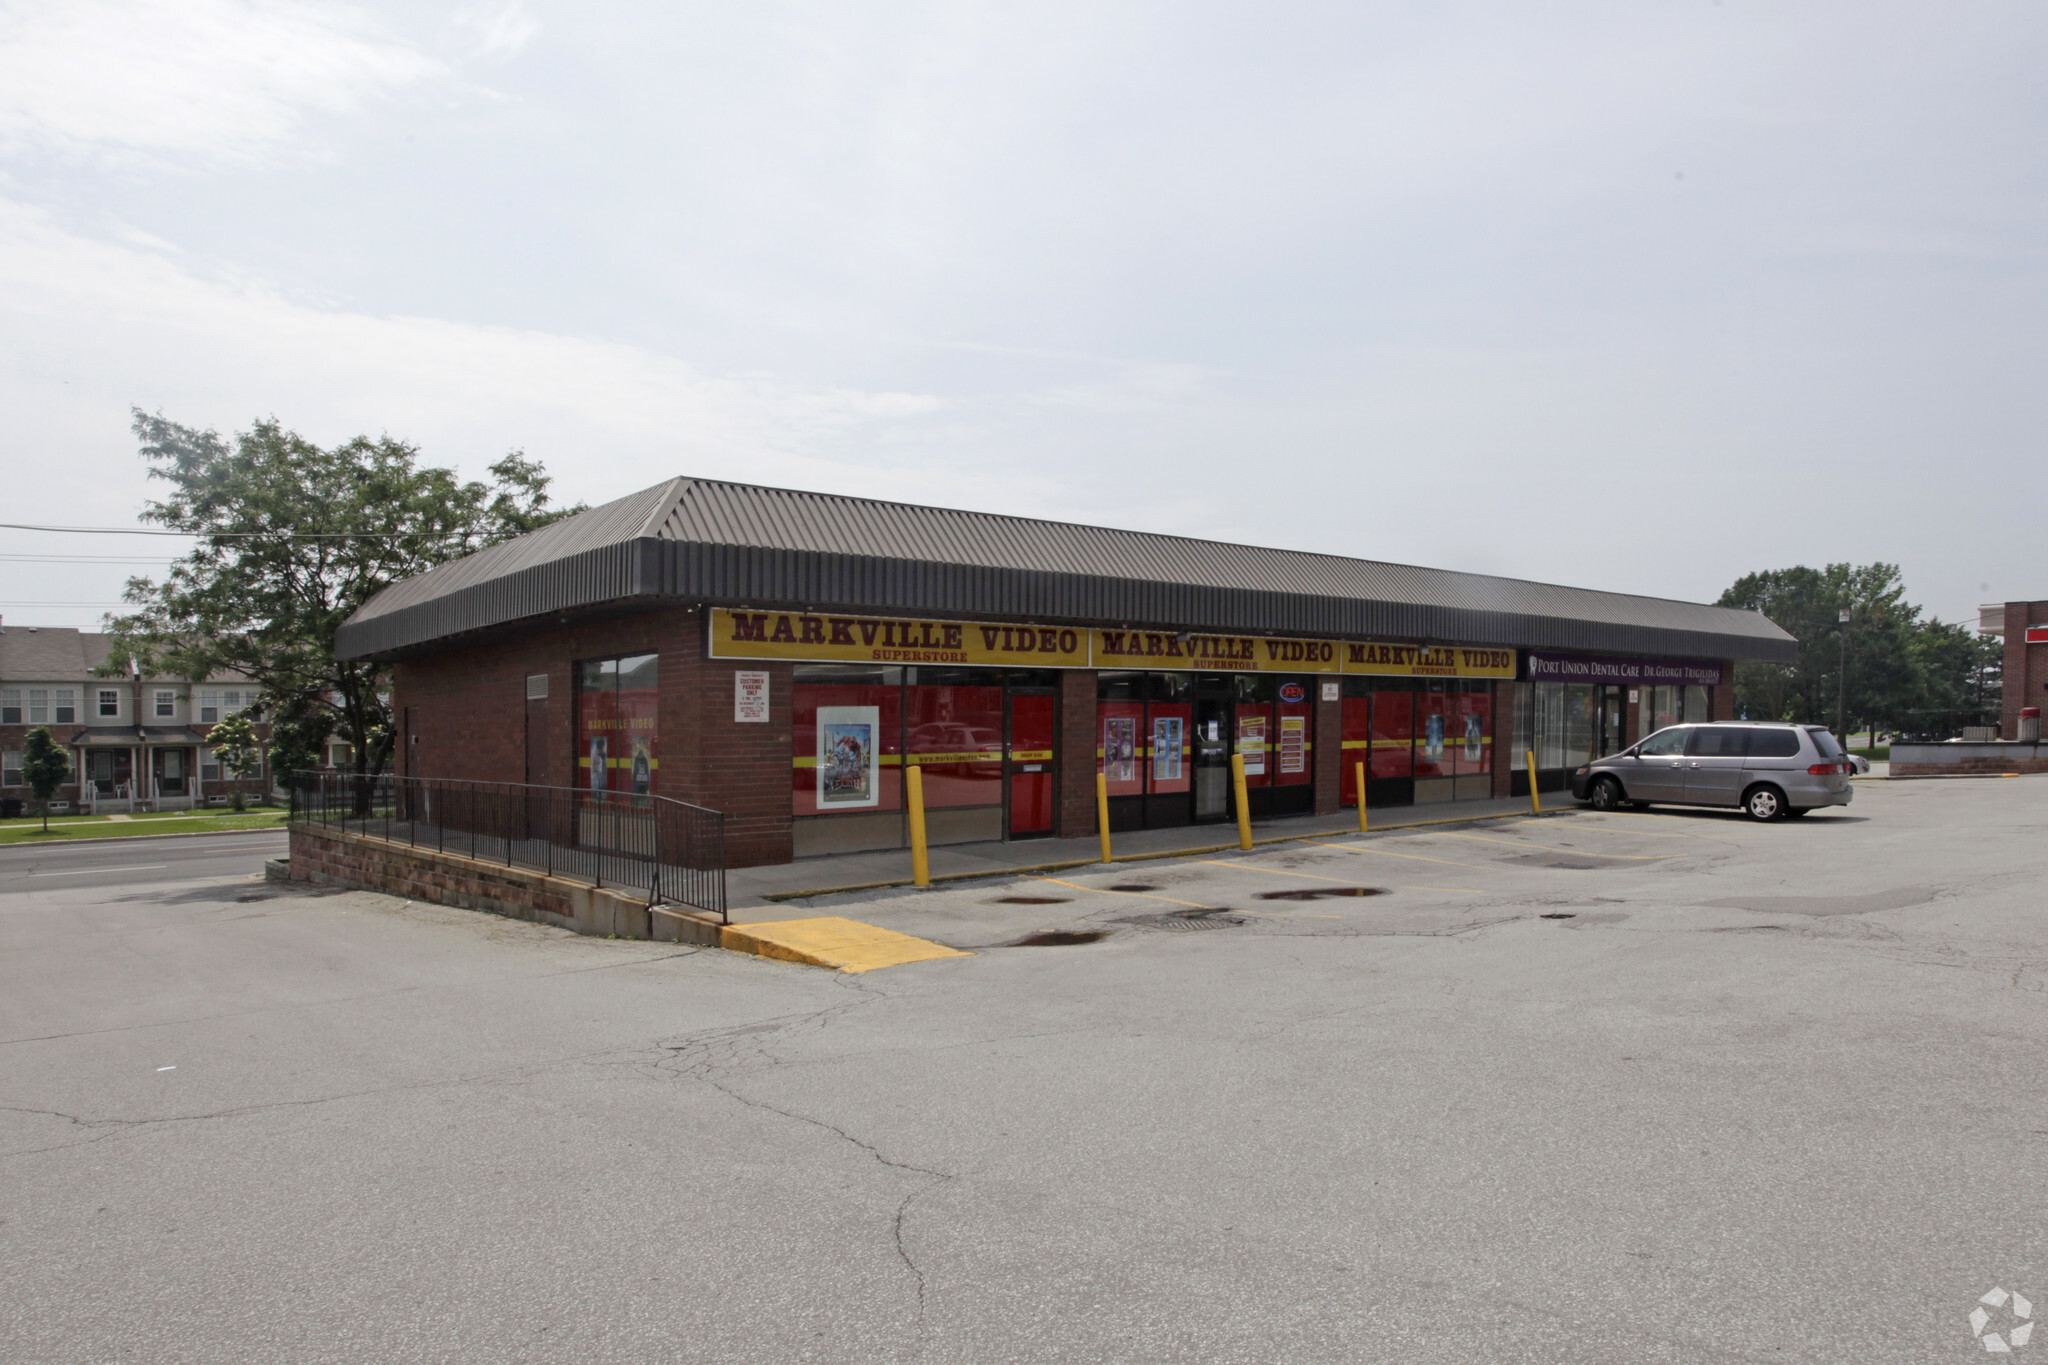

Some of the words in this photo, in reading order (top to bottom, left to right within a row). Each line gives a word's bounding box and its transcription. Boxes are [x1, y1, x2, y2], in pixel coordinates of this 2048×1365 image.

[731, 612, 962, 649] MARKVILLE
[979, 625, 1078, 654] VIDEO
[1101, 631, 1254, 660] MARKVILLE
[1265, 640, 1333, 663] VIDEO
[872, 649, 968, 663] SUPERSTORE
[1348, 644, 1454, 667] MARKVILLE
[1462, 650, 1510, 668] VIDEO
[1193, 659, 1258, 671] SUPERSTORE
[1412, 667, 1457, 676] SUPERSTORE
[1538, 659, 1560, 674] PORT
[1561, 660, 1589, 675] UNION
[1591, 662, 1620, 676] DENTAL
[1620, 664, 1639, 677] CARE
[1656, 666, 1682, 678] GEORGE
[1282, 686, 1305, 697] OPEN
[630, 717, 654, 730] VIDEO
